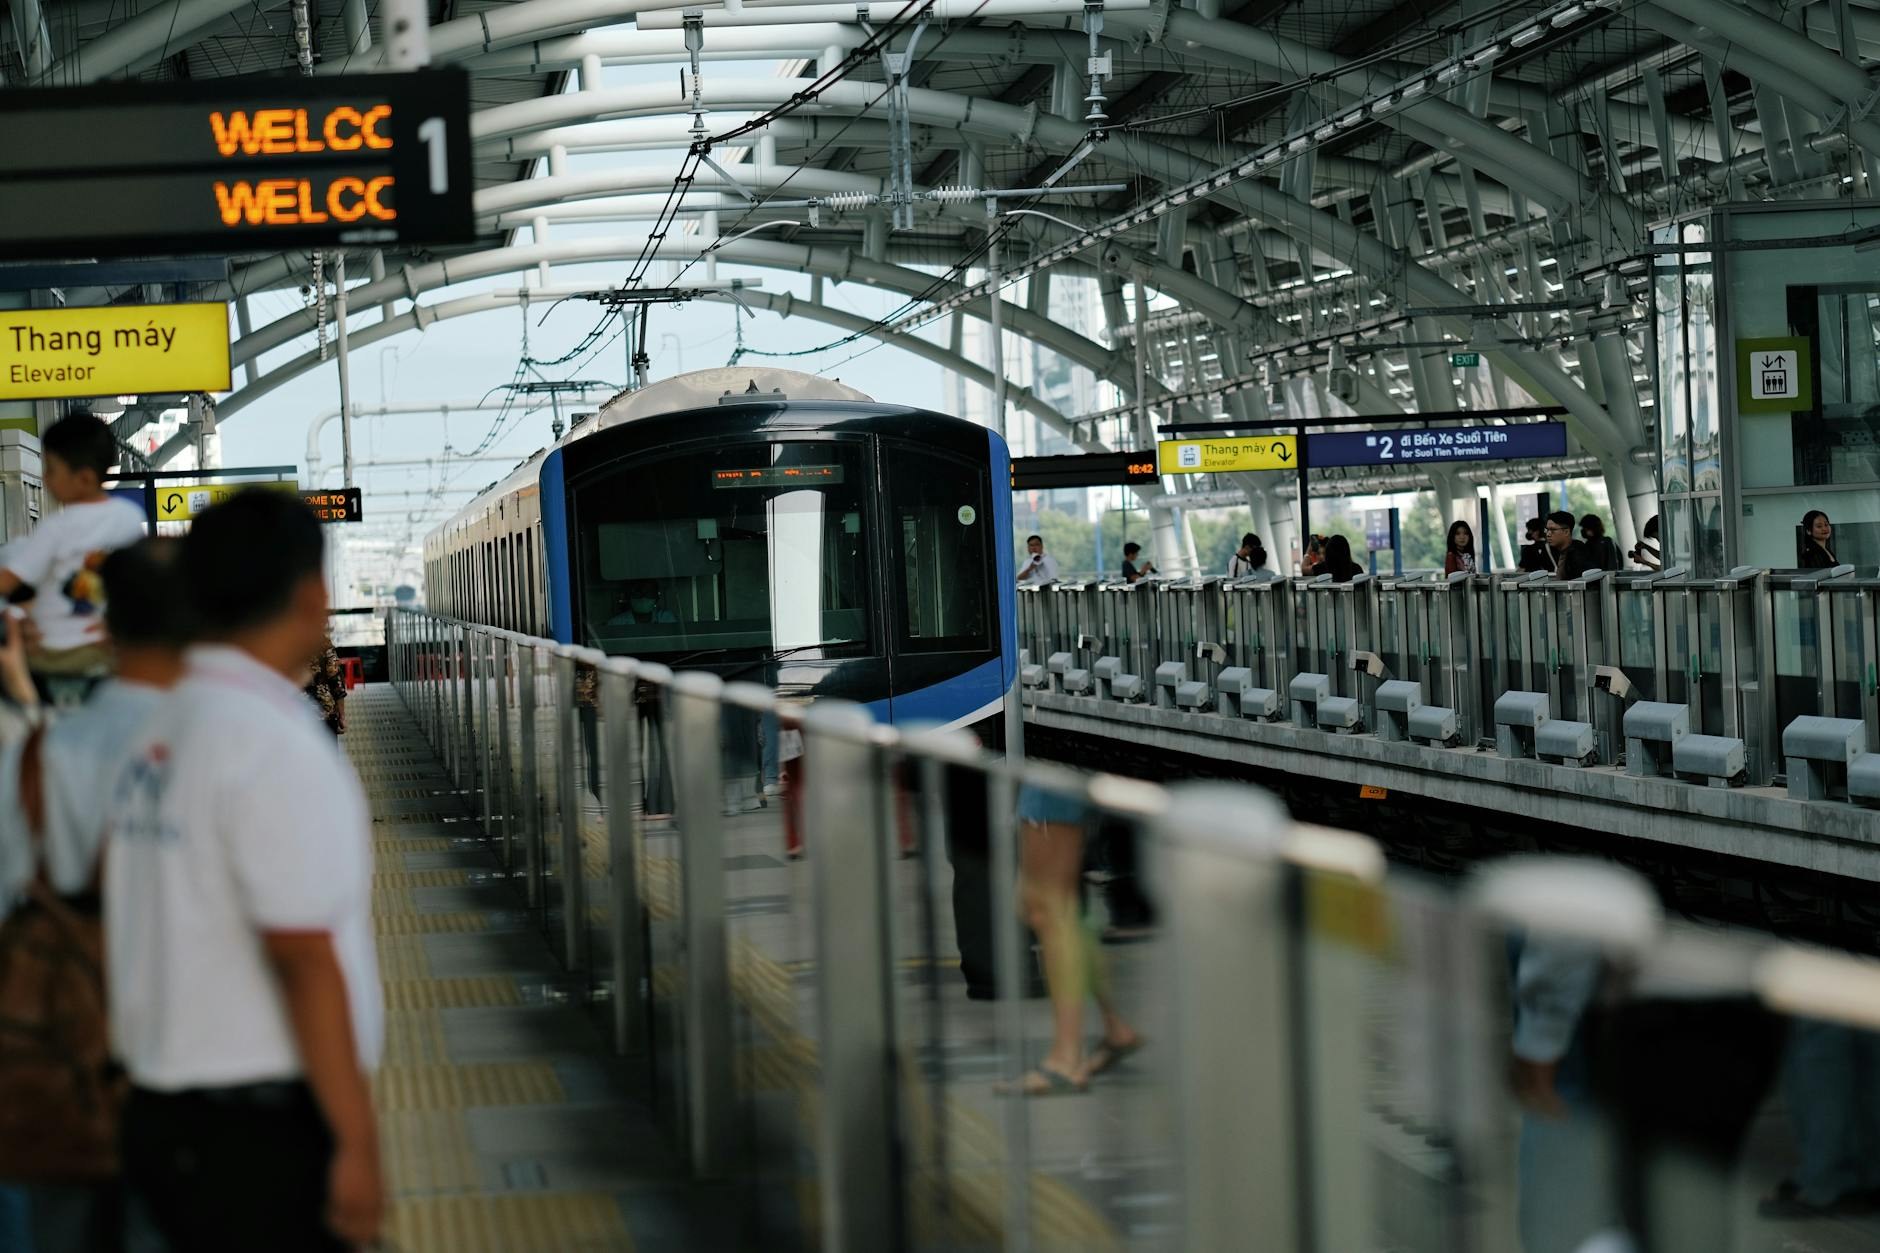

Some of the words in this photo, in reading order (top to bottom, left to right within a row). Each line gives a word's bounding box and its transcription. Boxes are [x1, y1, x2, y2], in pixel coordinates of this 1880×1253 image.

[418, 116, 449, 195] 1
[9, 326, 101, 356] Thang
[114, 320, 176, 352] máy
[1456, 354, 1475, 366] EXIT
[10, 364, 95, 384] Elevator
[1204, 444, 1239, 457] Thang
[1379, 436, 1394, 459] 2
[1414, 432, 1437, 446] Bến
[1438, 433, 1453, 445] Xe
[1455, 430, 1481, 444] Suối
[1483, 430, 1508, 443] Tiên
[1453, 444, 1489, 456] Terminal
[1127, 463, 1154, 475] 16:42
[330, 494, 346, 506] TO
[350, 496, 359, 514] 1
[331, 508, 347, 519] TO
